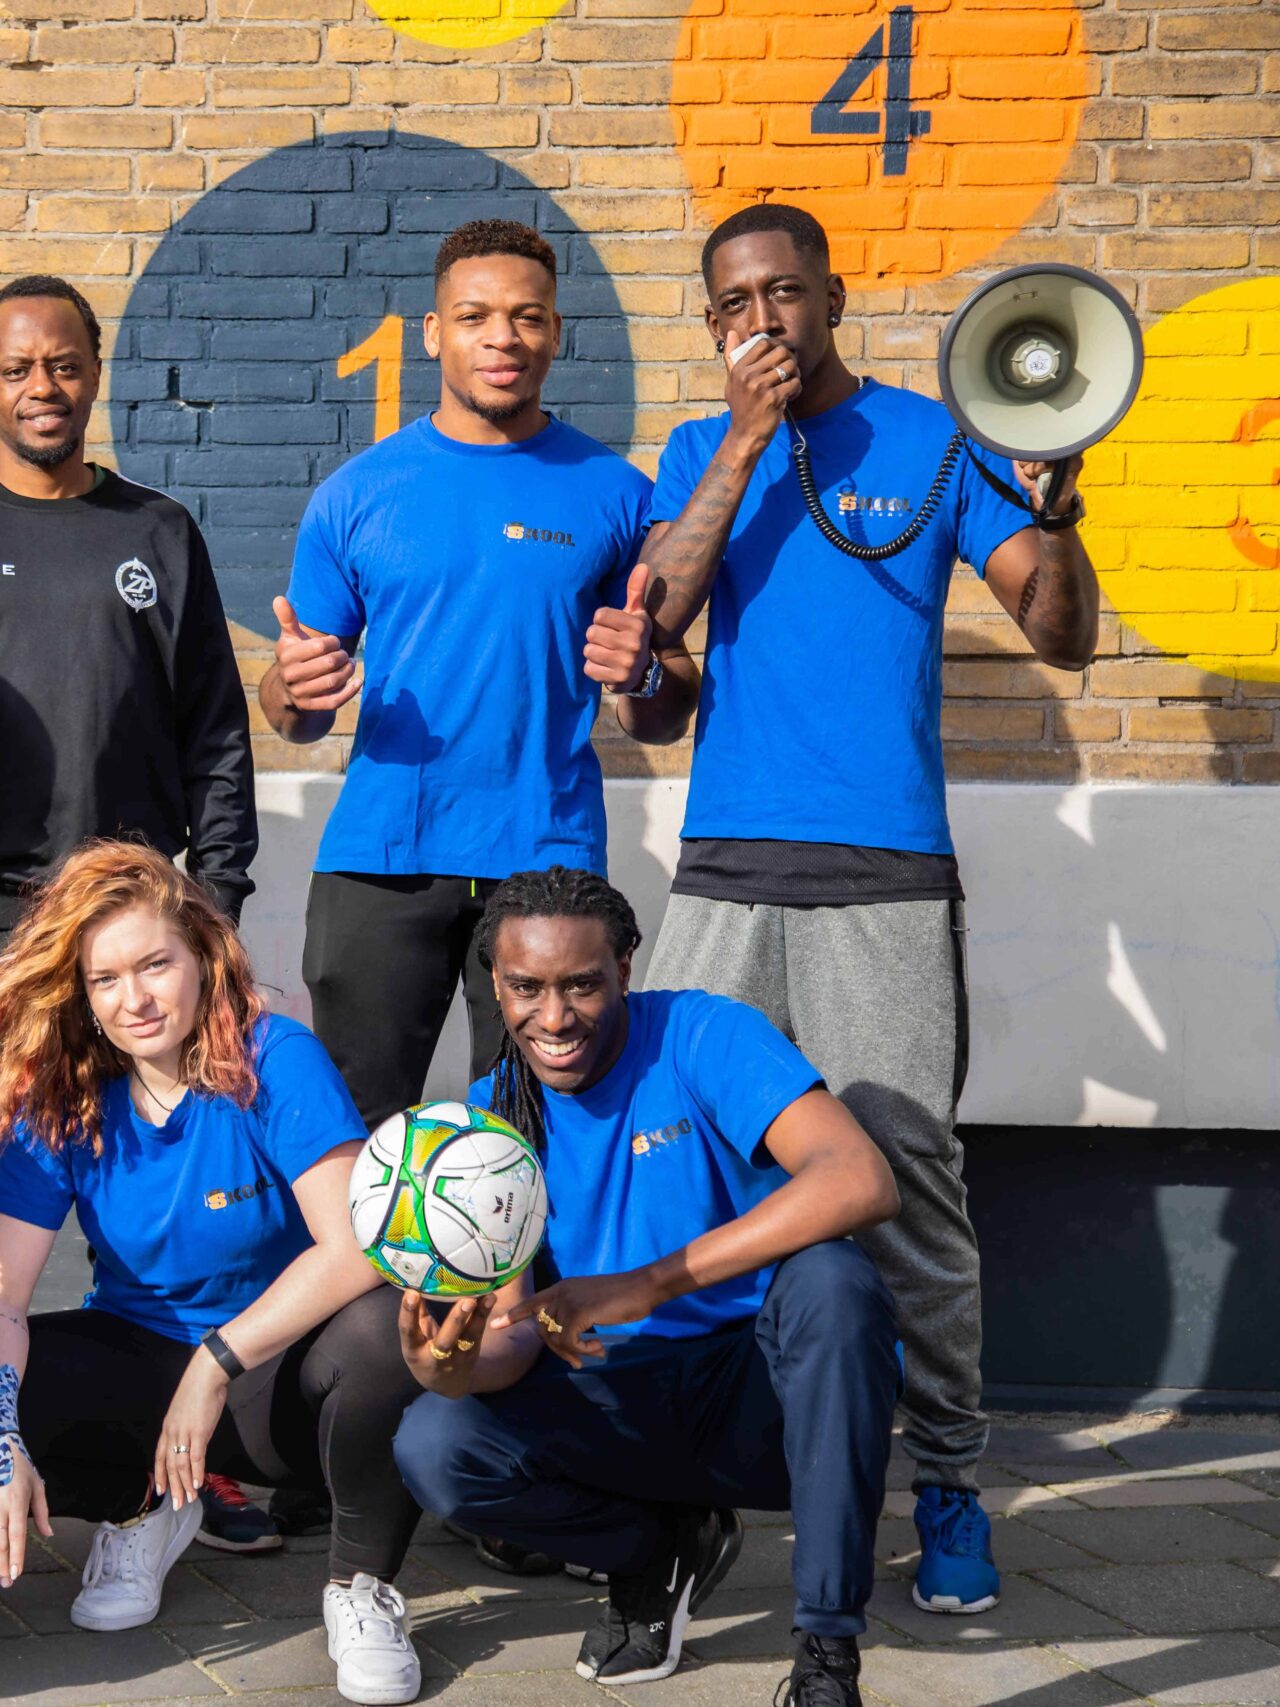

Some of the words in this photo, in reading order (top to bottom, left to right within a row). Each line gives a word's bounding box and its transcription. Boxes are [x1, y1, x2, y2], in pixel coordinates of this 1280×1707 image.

[811, 5, 931, 176] 4
[337, 315, 403, 443] 1
[506, 524, 576, 547] SKOOL
[504, 1191, 514, 1224] erima
